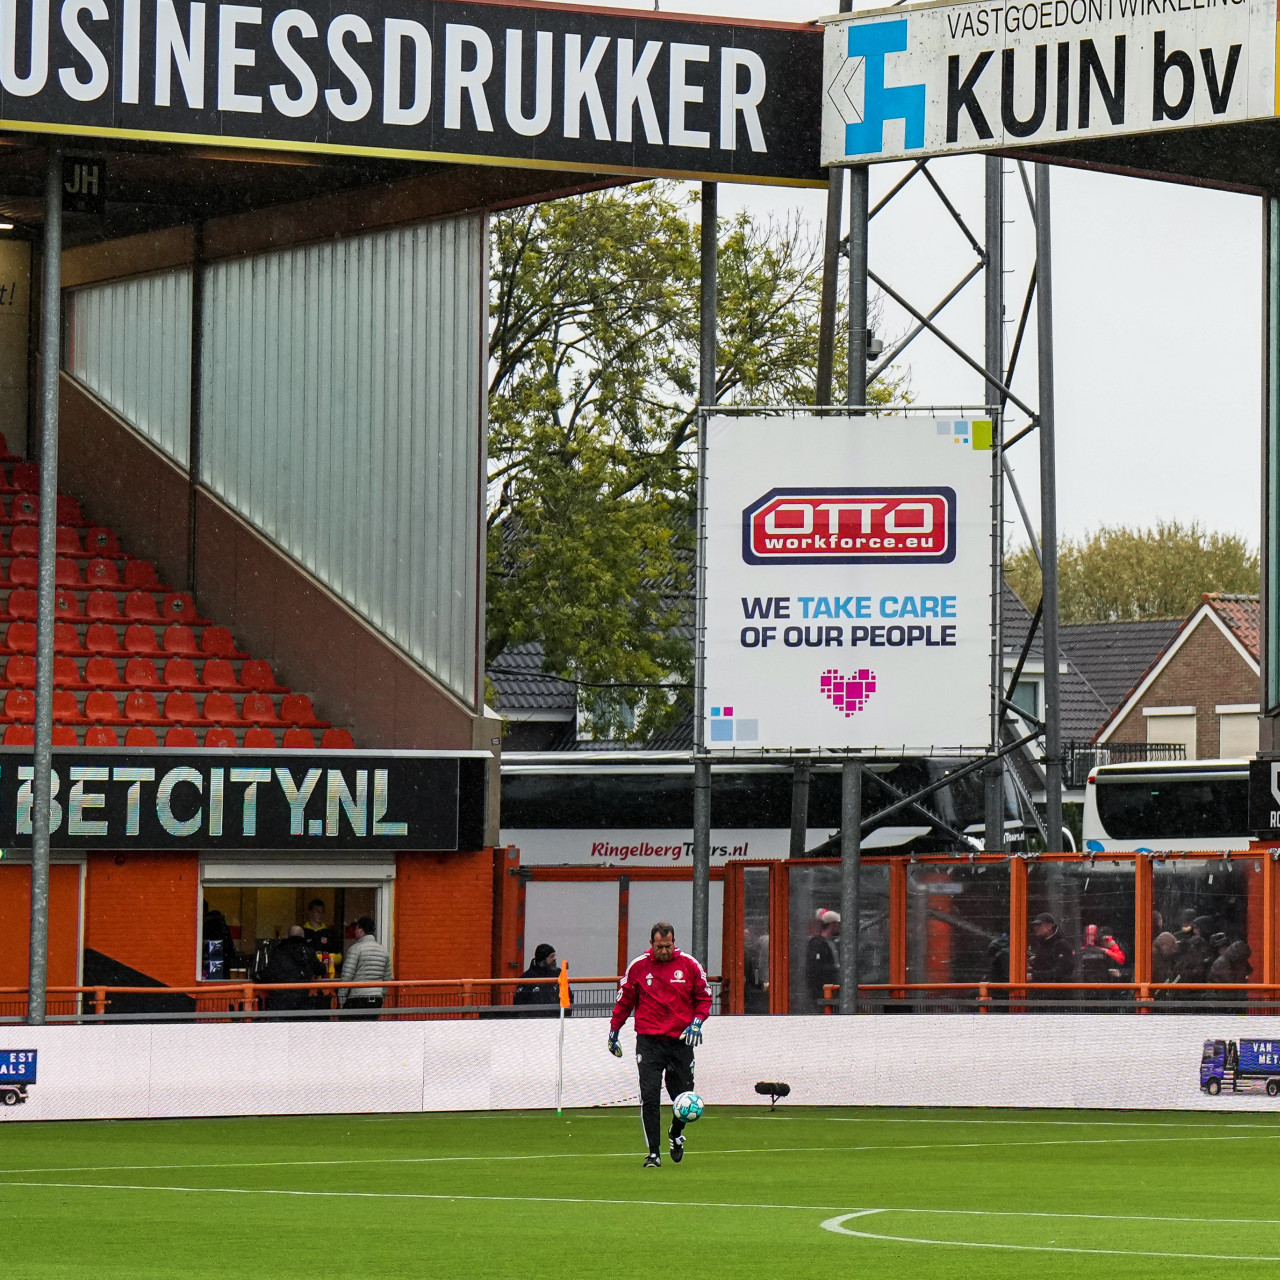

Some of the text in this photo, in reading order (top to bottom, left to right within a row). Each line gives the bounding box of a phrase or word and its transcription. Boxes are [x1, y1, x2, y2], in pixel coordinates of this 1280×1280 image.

[945, 34, 1127, 144] KUIN
[1152, 30, 1243, 122] bv
[64, 162, 100, 196] JH
[764, 502, 934, 535] OTTO
[764, 534, 935, 549] workforce.eu
[741, 595, 957, 620] WE TAKE CARE
[740, 624, 957, 648] OF OUR PEOPLE
[15, 765, 409, 837] BETCITY.NL
[9, 1053, 34, 1063] EST
[1252, 1042, 1272, 1053] VAN
